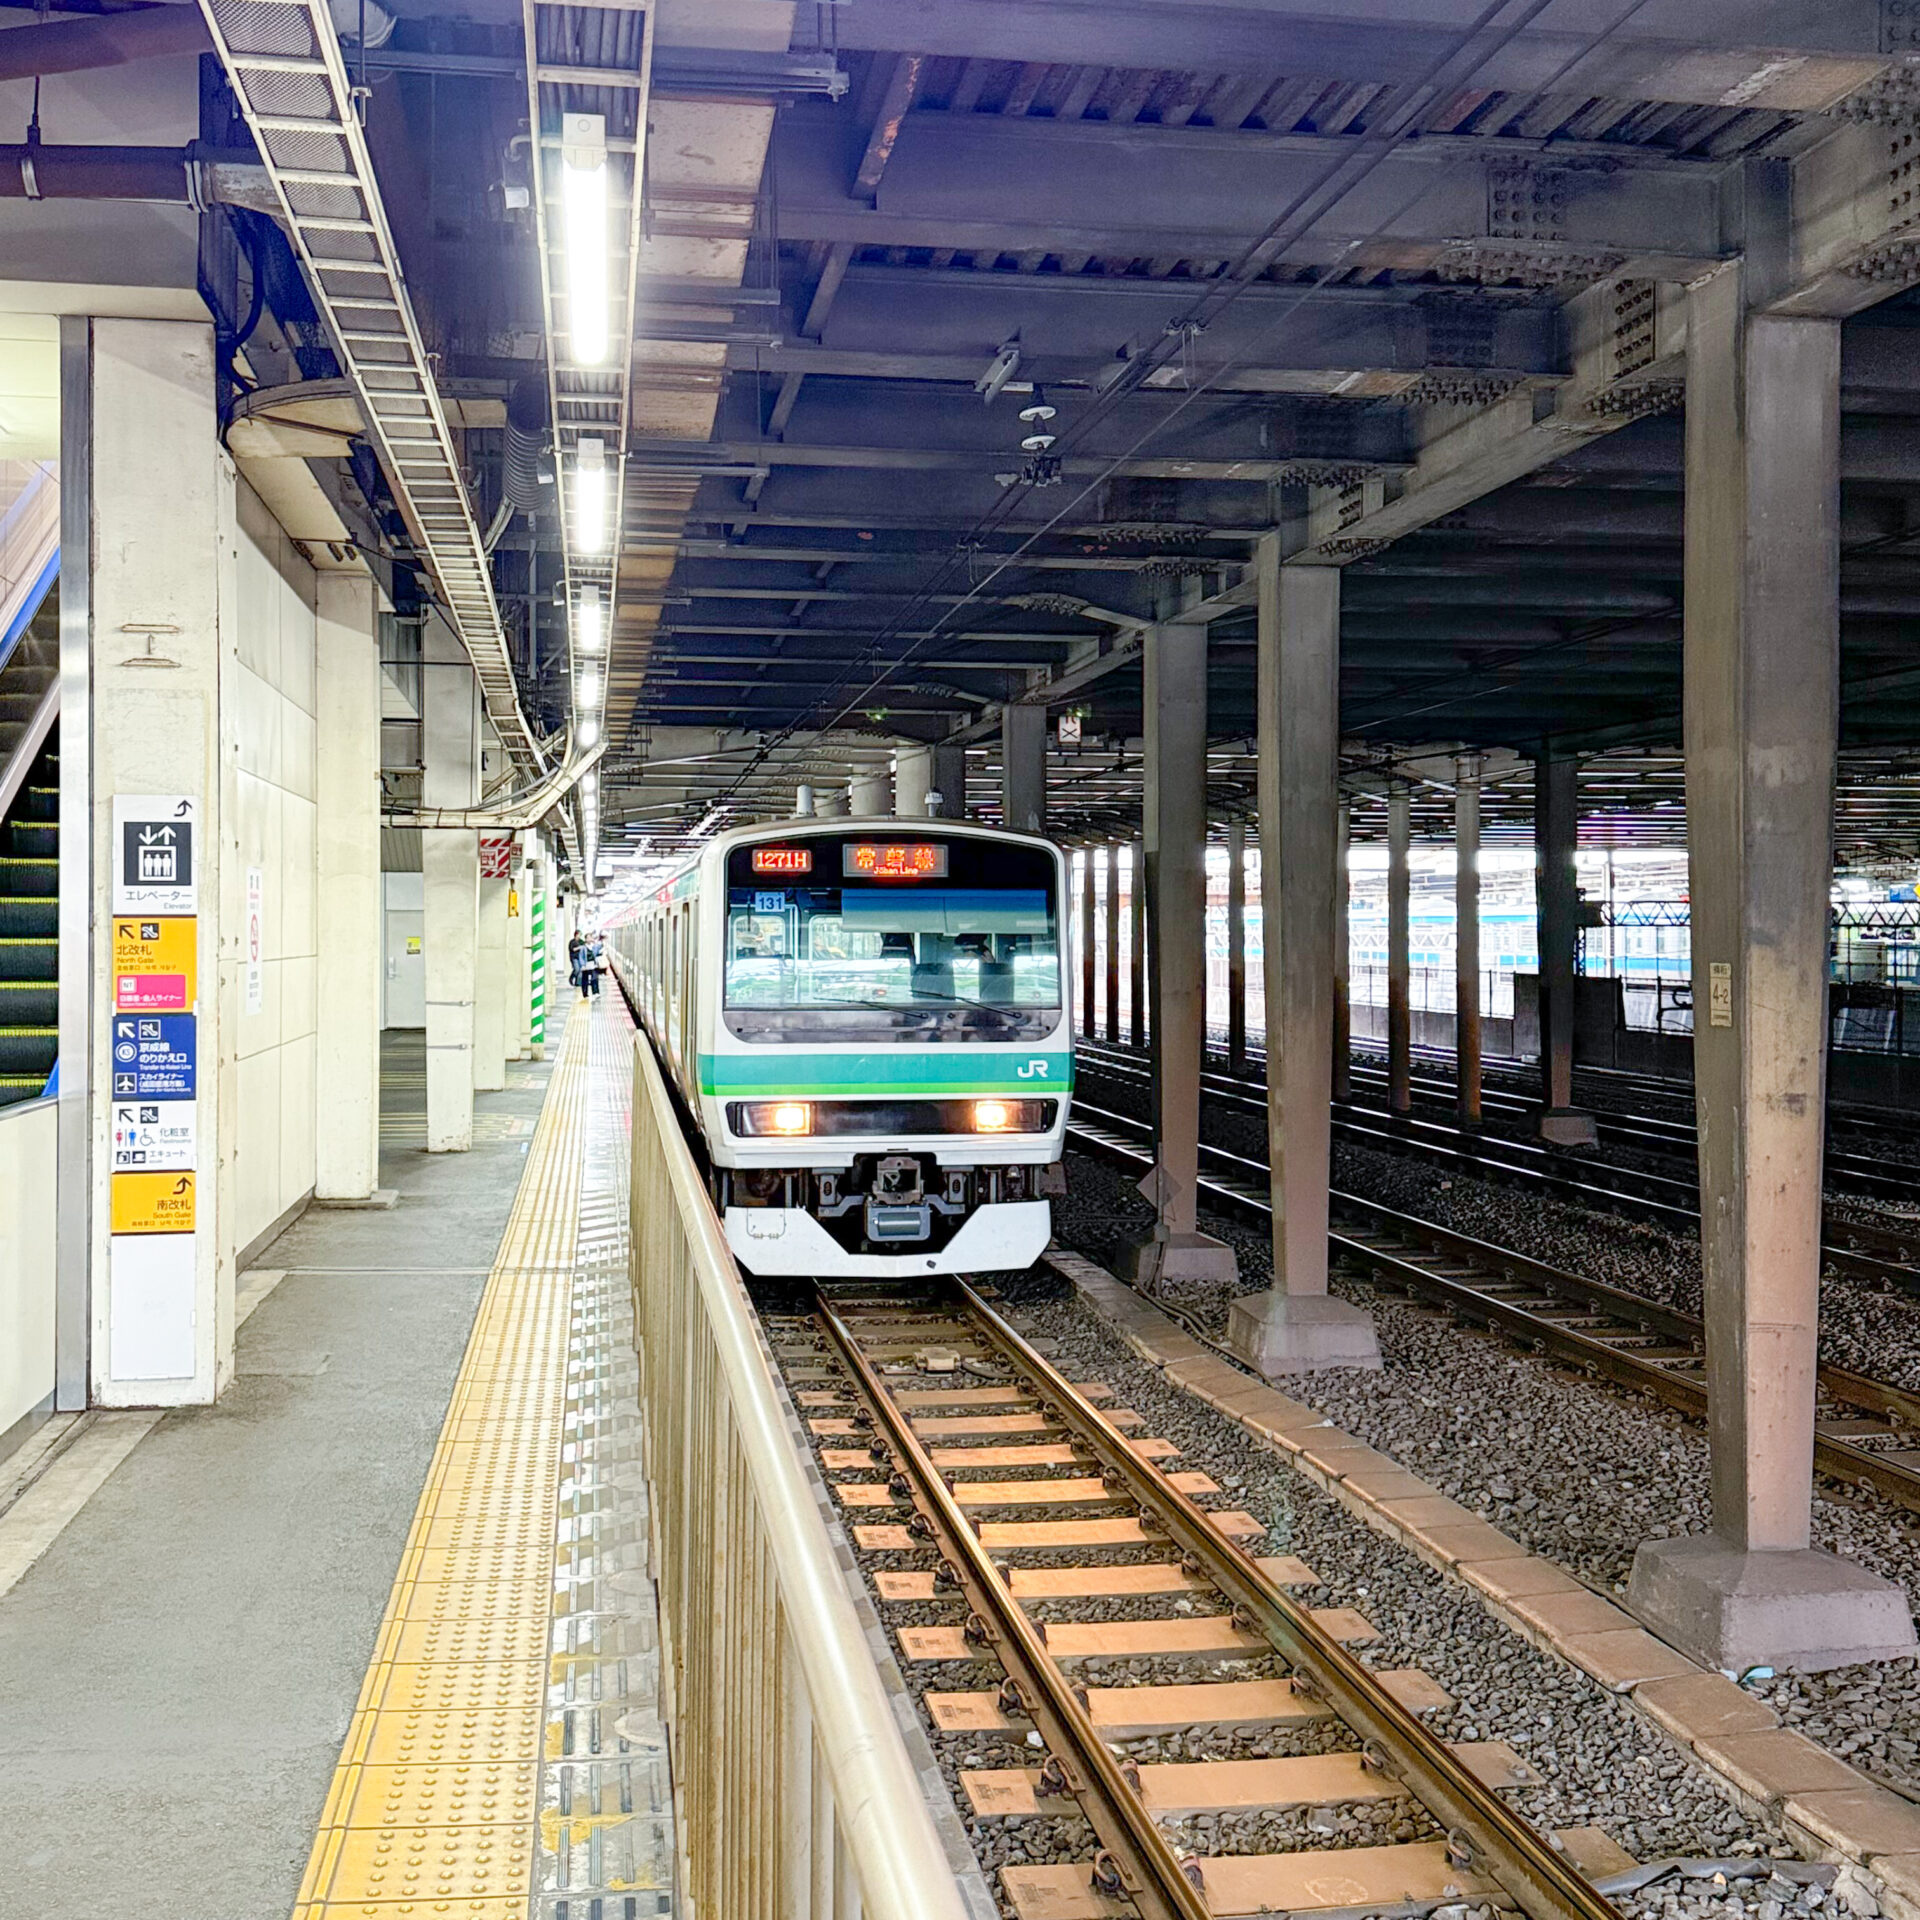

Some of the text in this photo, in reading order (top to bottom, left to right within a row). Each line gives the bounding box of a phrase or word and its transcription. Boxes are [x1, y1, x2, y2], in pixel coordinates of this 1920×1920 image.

[757, 852, 807, 868] 1271H
[900, 862, 918, 875] Line
[125, 890, 193, 901] エレベーター
[759, 898, 782, 910] 131
[116, 944, 152, 956] 北改札
[139, 1042, 170, 1053] 京成線
[139, 1053, 187, 1064] のりかえ口
[1017, 1060, 1048, 1078] JR
[160, 1127, 190, 1138] 化粧室
[149, 1150, 187, 1158] エキュート
[157, 1199, 191, 1210] 南改札
[153, 1211, 192, 1219] South Gate
